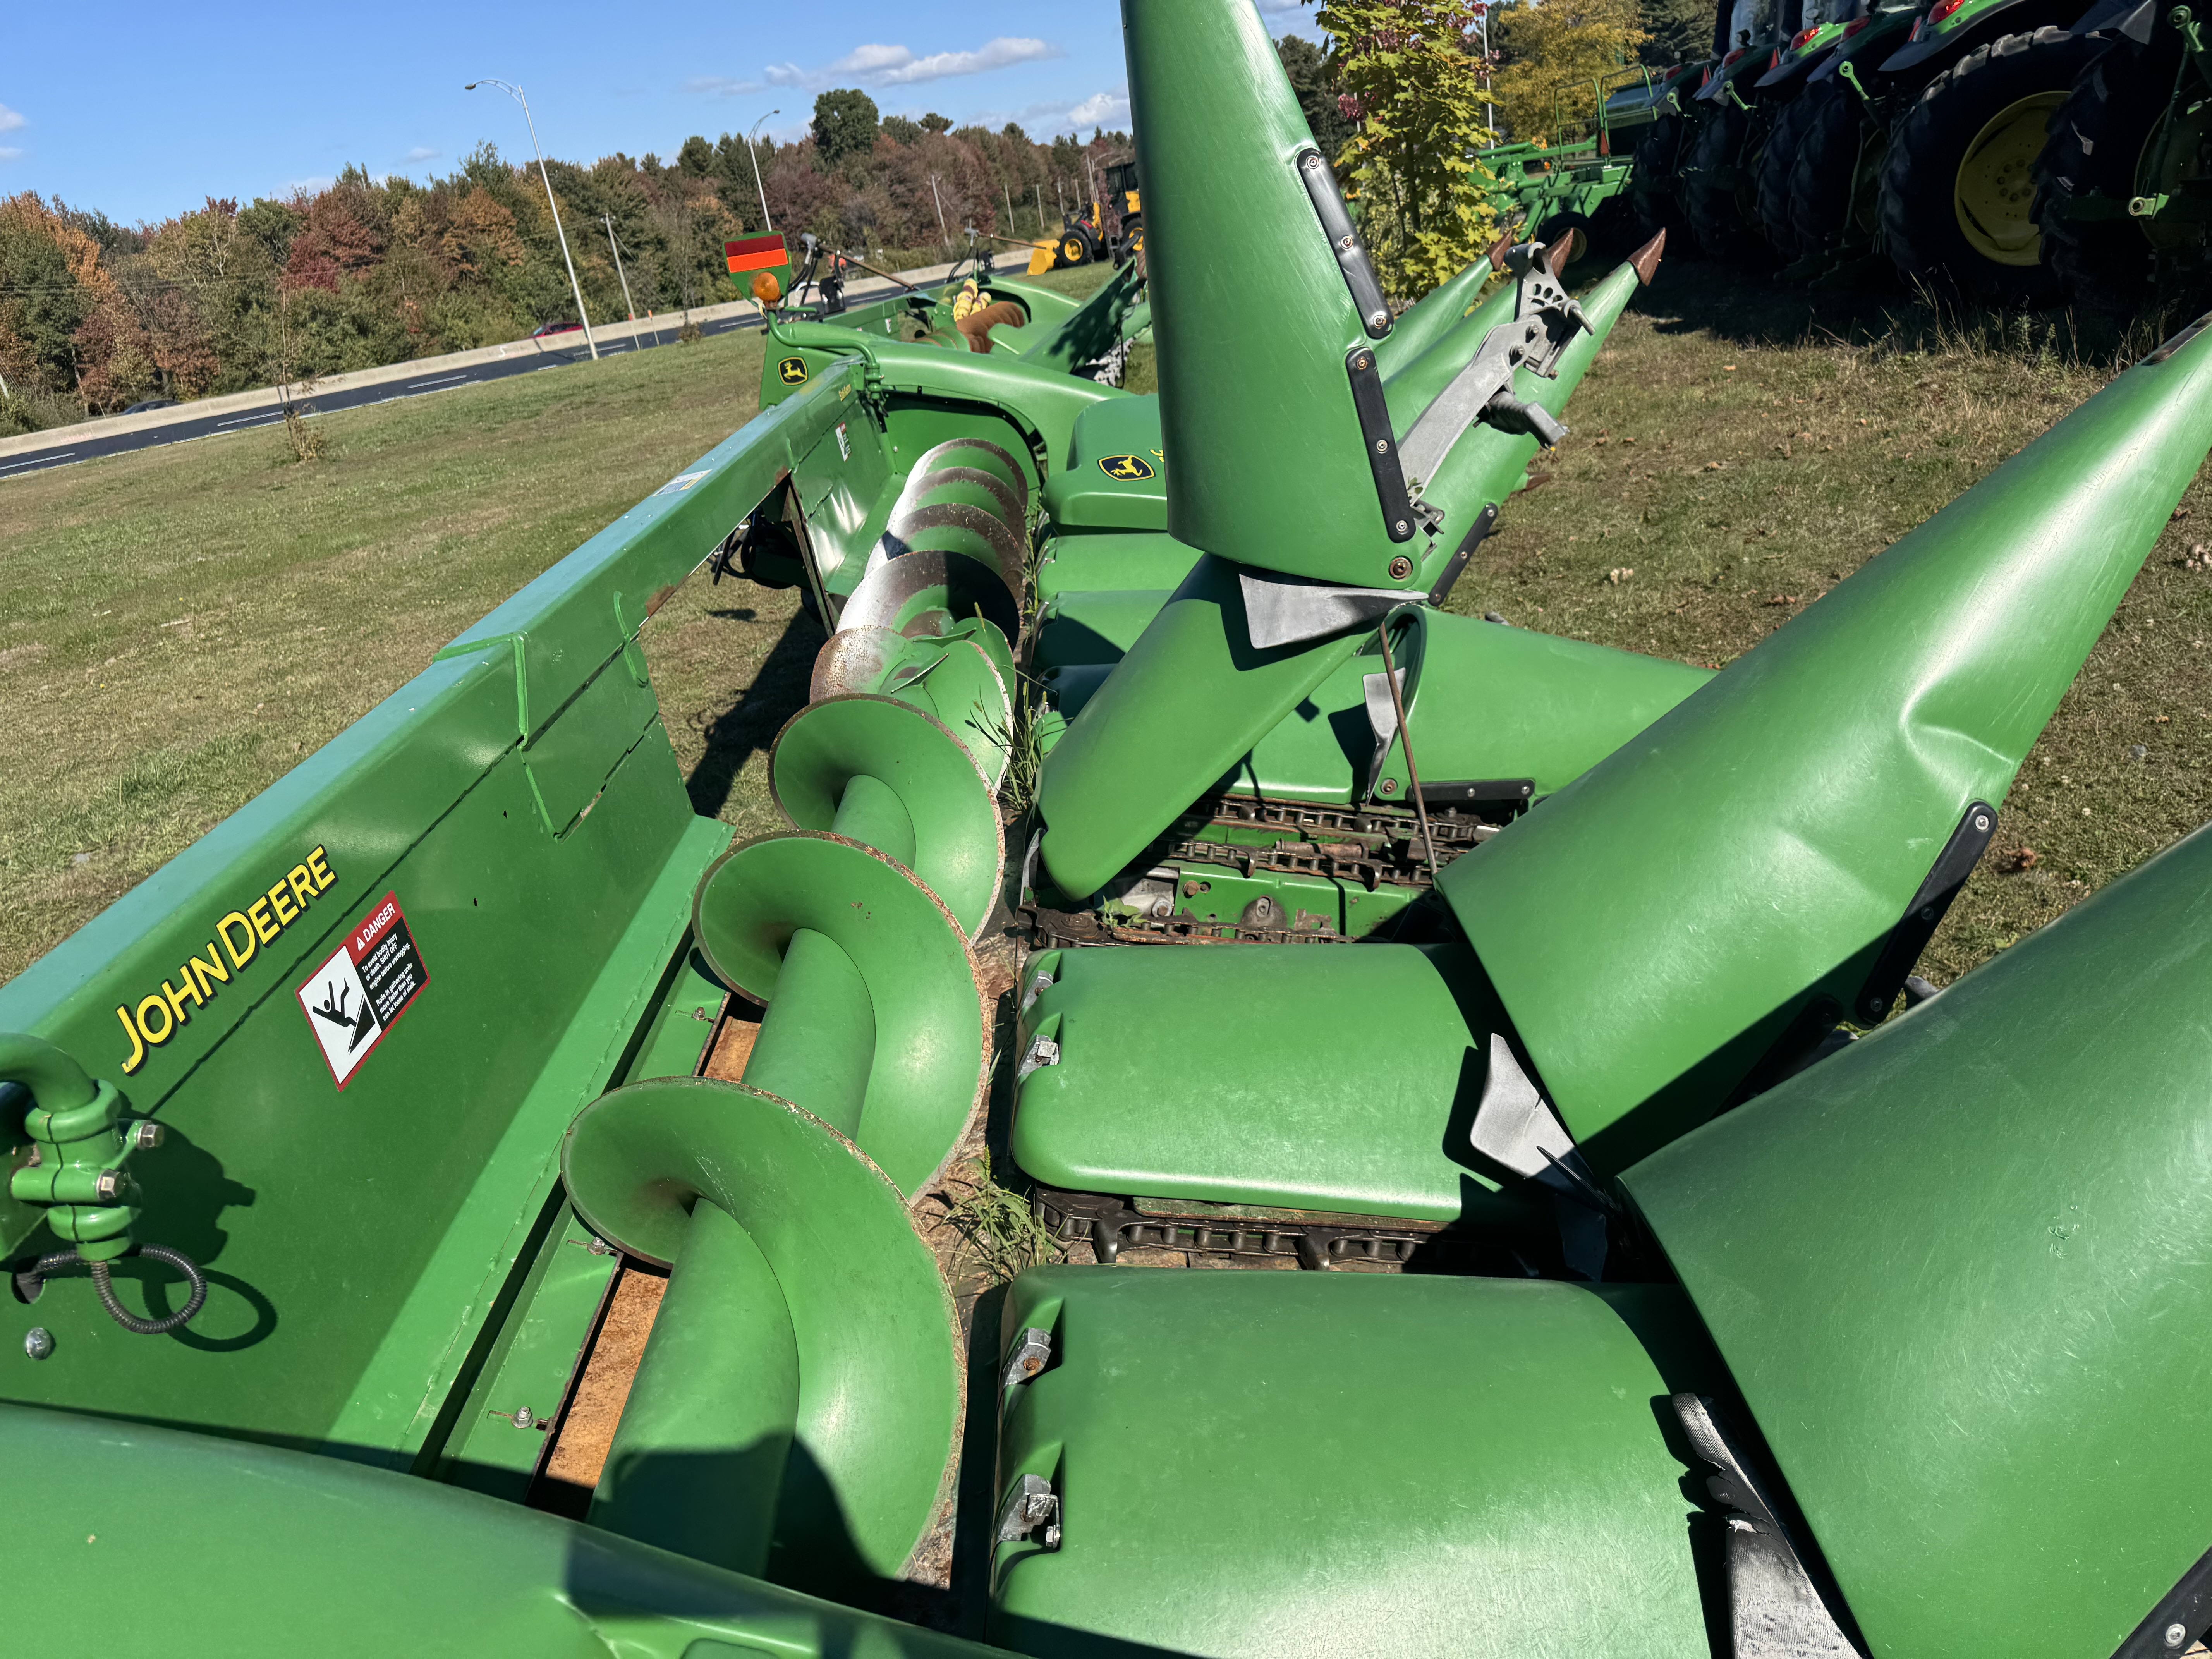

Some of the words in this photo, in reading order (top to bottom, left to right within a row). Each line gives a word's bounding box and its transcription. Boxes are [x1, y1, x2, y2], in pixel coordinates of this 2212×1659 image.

[362, 903, 395, 942] DANGER
[116, 939, 235, 1077] JOHN
[215, 844, 339, 972] DEERE
[368, 953, 378, 968] avoid
[376, 944, 388, 957] bodily
[386, 933, 397, 946] injury
[370, 963, 381, 976] death,
[380, 950, 390, 964] SHUT
[370, 975, 381, 989] engine
[381, 963, 392, 977] before
[392, 943, 410, 965] unclogging.
[389, 972, 405, 993] gathering
[404, 963, 412, 974] units
[380, 1001, 390, 1014] move
[388, 989, 398, 1003] faster
[398, 981, 406, 991] than
[393, 995, 403, 1008] loose
